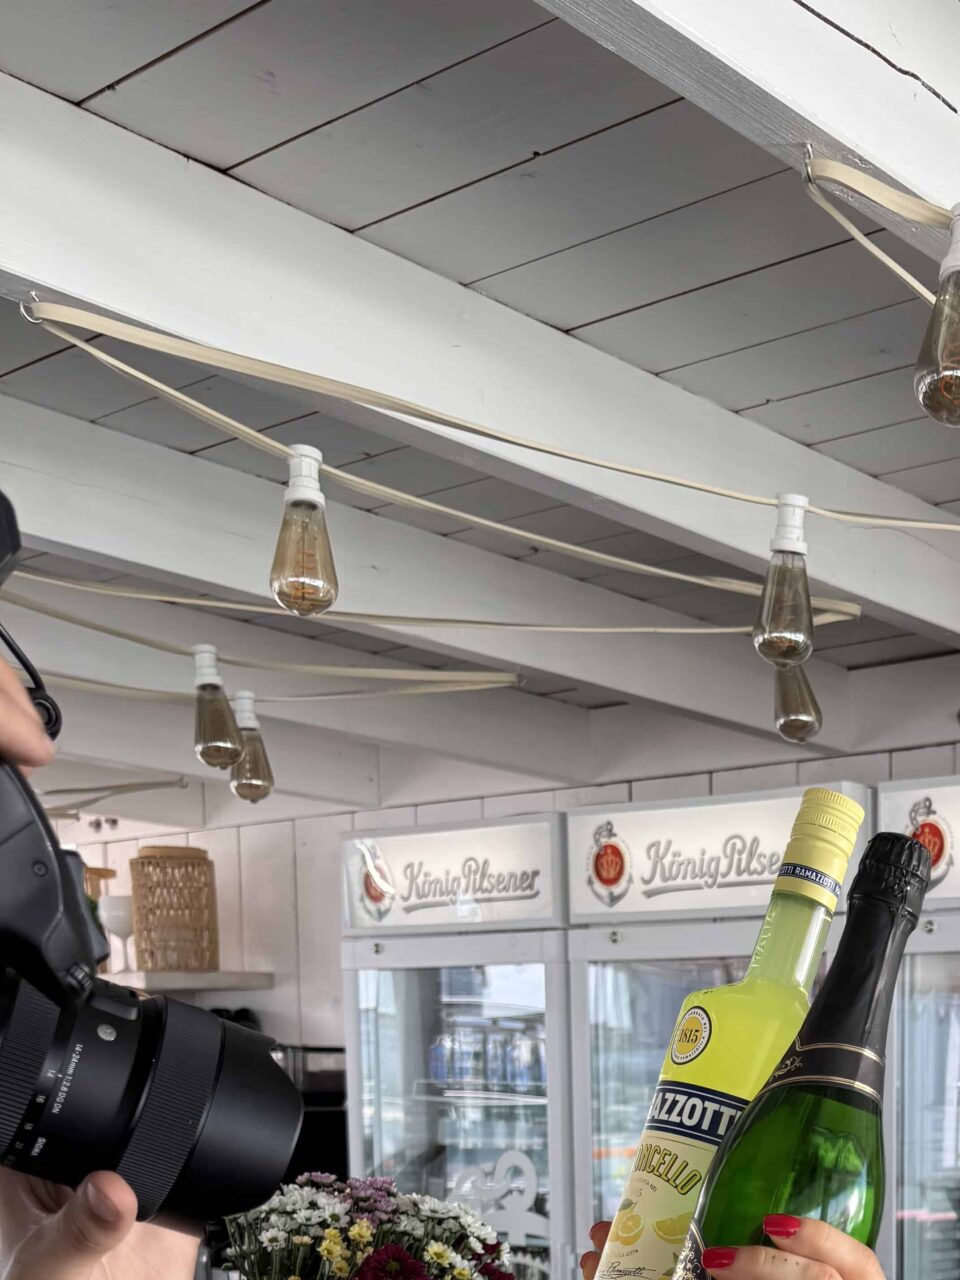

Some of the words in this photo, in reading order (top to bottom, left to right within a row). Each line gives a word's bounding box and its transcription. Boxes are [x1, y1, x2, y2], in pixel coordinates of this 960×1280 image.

[640, 839, 721, 889] König
[720, 834, 781, 879] Pilse
[794, 866, 836, 891] RAMAZZOTTI
[400, 861, 461, 905] König
[461, 857, 541, 895] Pilsener
[678, 1027, 701, 1044] 1815
